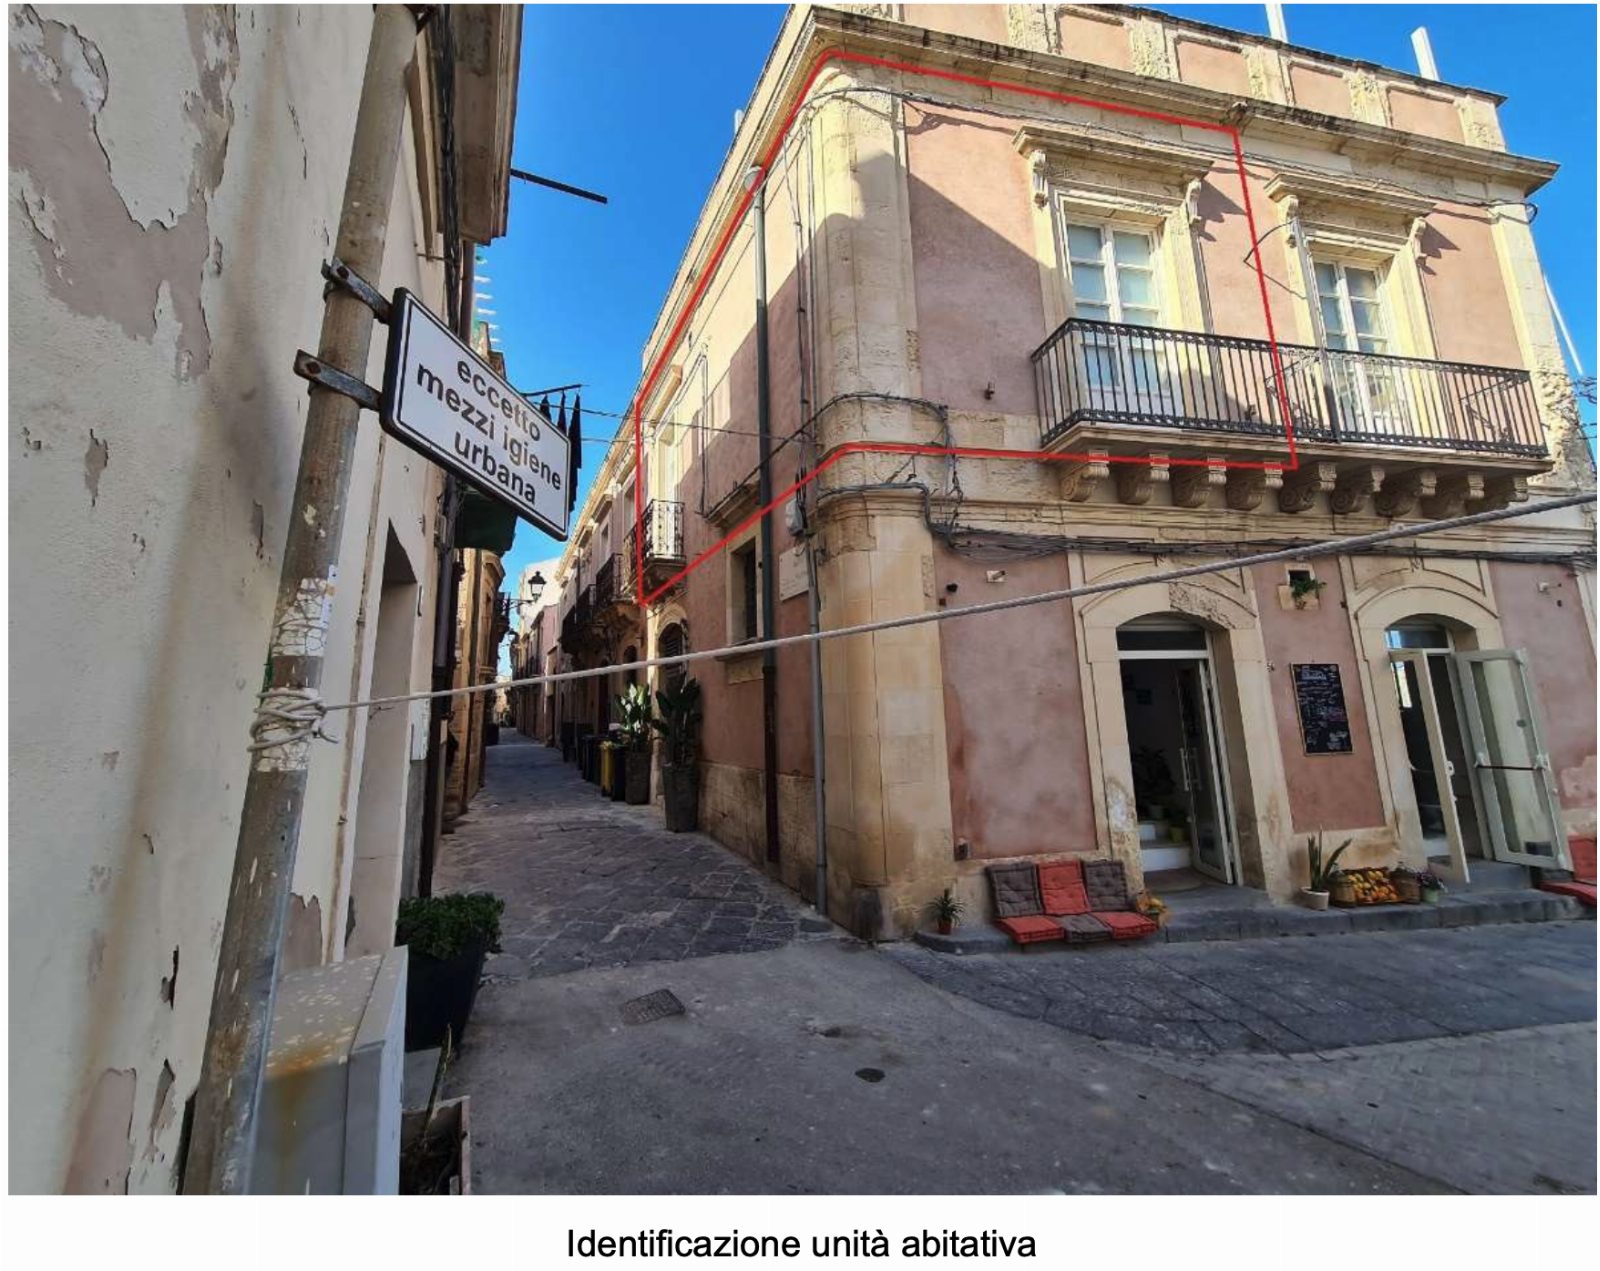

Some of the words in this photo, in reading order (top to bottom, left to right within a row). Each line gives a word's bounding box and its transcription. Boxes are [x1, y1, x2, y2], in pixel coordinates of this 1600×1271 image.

[417, 364, 494, 440] mezzi
[504, 426, 561, 490] igiene
[457, 361, 540, 441] eccetto
[455, 432, 535, 504] urbana
